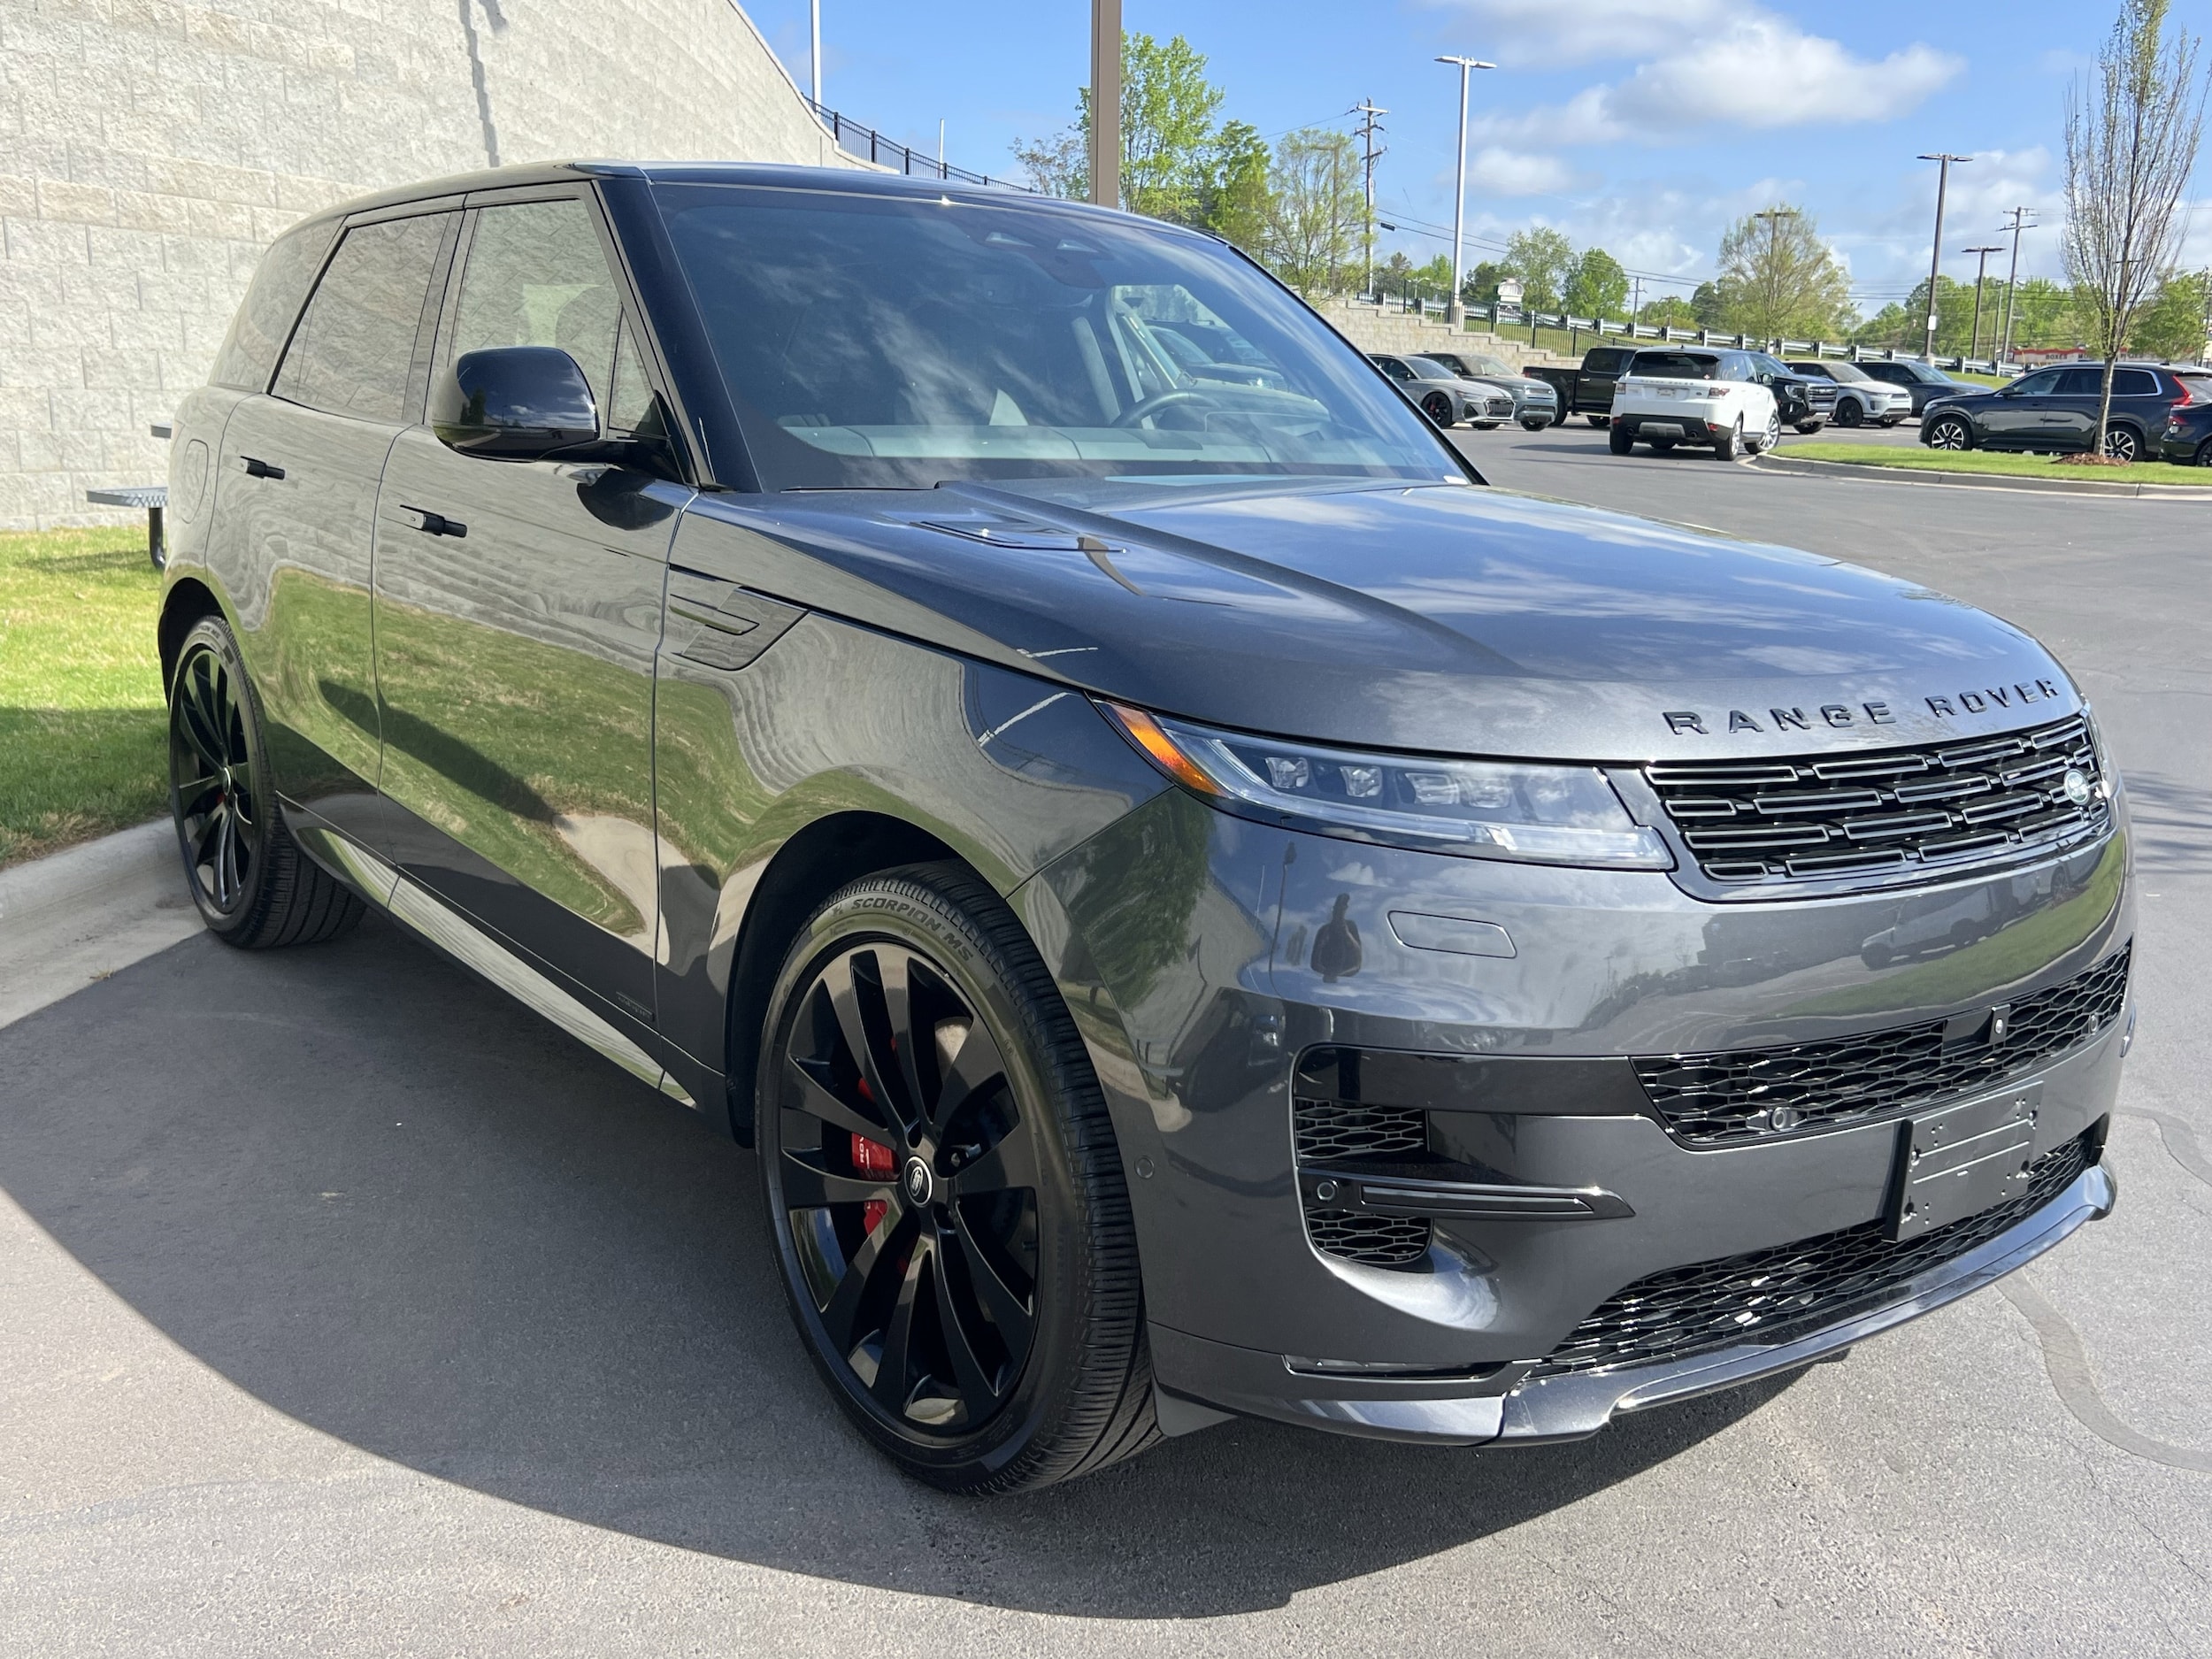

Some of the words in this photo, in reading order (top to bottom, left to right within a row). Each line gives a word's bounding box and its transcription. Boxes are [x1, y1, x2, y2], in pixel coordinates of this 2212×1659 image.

[1662, 702, 1897, 735] RANGE
[1924, 677, 2060, 718] ROVER
[851, 897, 942, 932] SCORPION
[943, 933, 973, 962] MS
